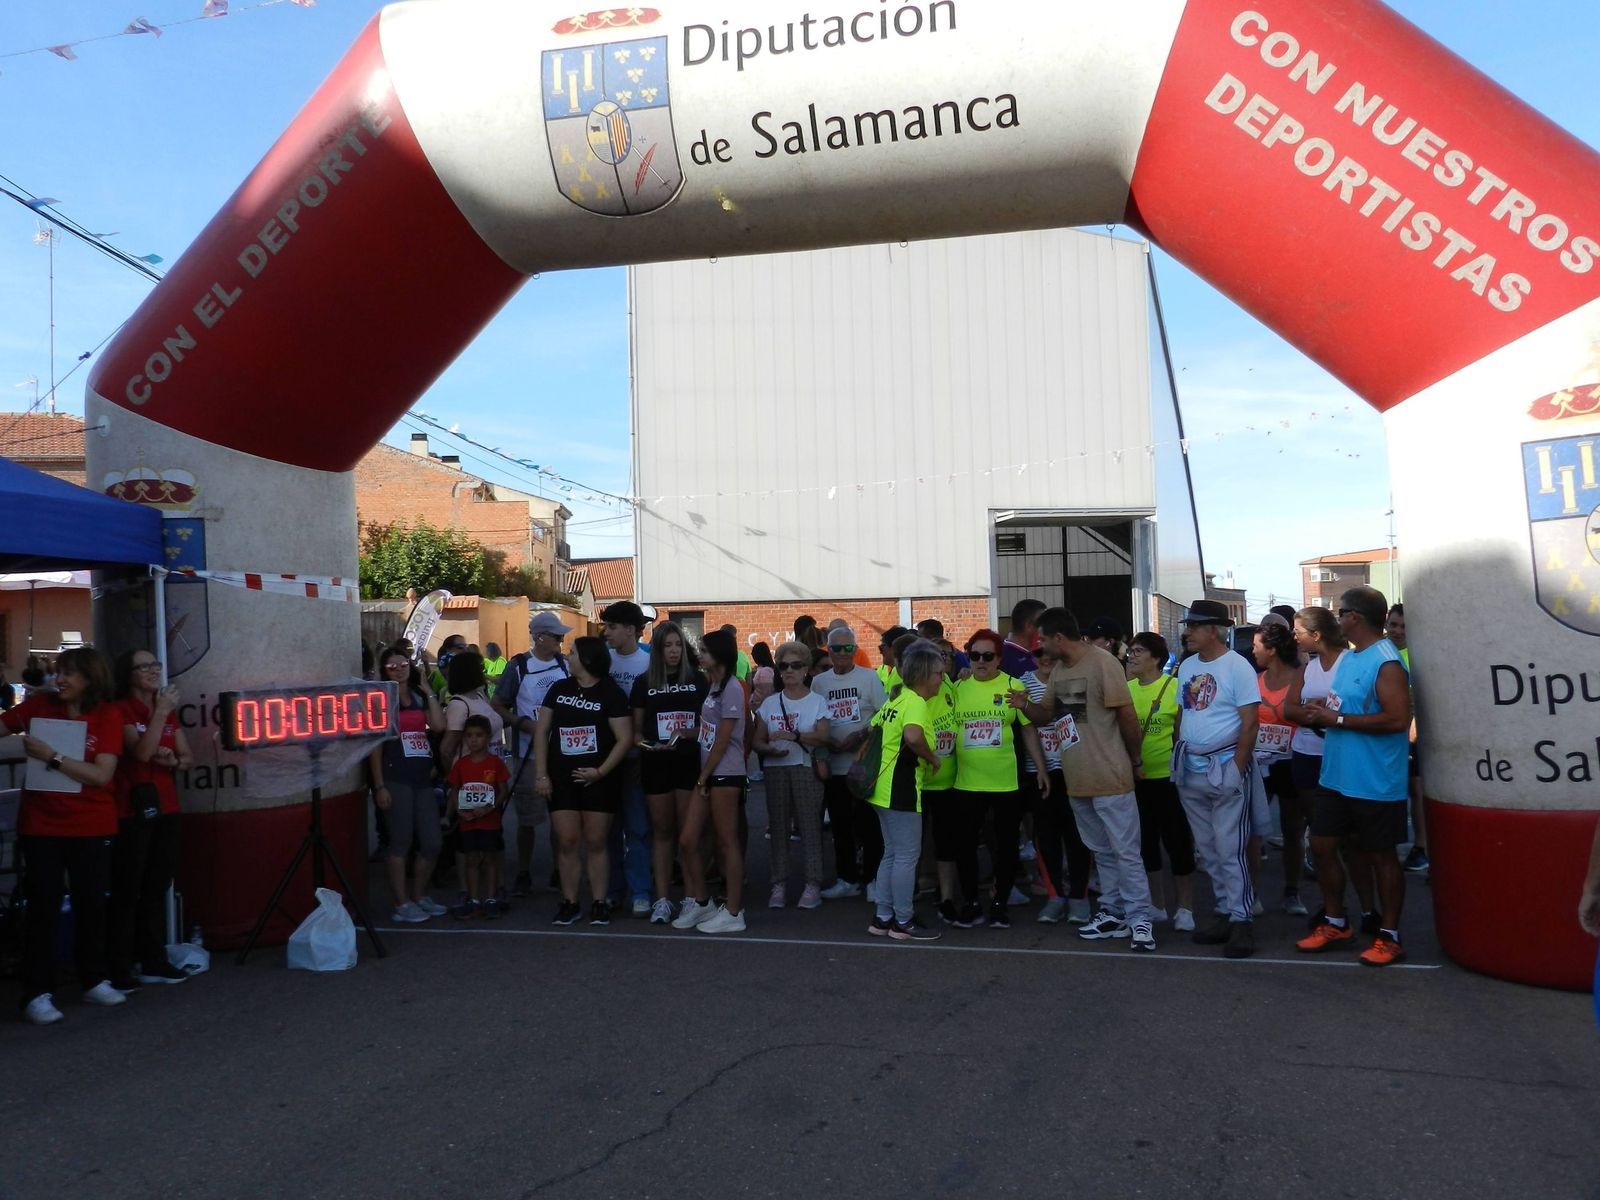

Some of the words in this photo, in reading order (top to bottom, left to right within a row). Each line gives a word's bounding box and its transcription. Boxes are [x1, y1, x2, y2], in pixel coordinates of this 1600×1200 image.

[683, 0, 957, 71] Diputación
[690, 129, 733, 166] de
[751, 93, 1021, 159] Salamanca
[1230, 10, 1337, 95] CON
[1333, 81, 1600, 274] NUESTROS
[1204, 72, 1532, 312] DEPORTISTAS
[126, 325, 196, 405] CON
[193, 284, 242, 328] EL
[237, 100, 393, 278] DEPORTE
[647, 683, 697, 696] adidas
[829, 687, 858, 700] PUMA
[556, 695, 602, 711] adidas
[833, 707, 852, 719] 408
[666, 721, 687, 731] 405
[970, 729, 993, 740] 447
[1259, 733, 1281, 745] 393
[410, 741, 428, 750] 386
[567, 736, 588, 747] 392
[1476, 749, 1513, 782] de
[466, 792, 487, 802] 552
